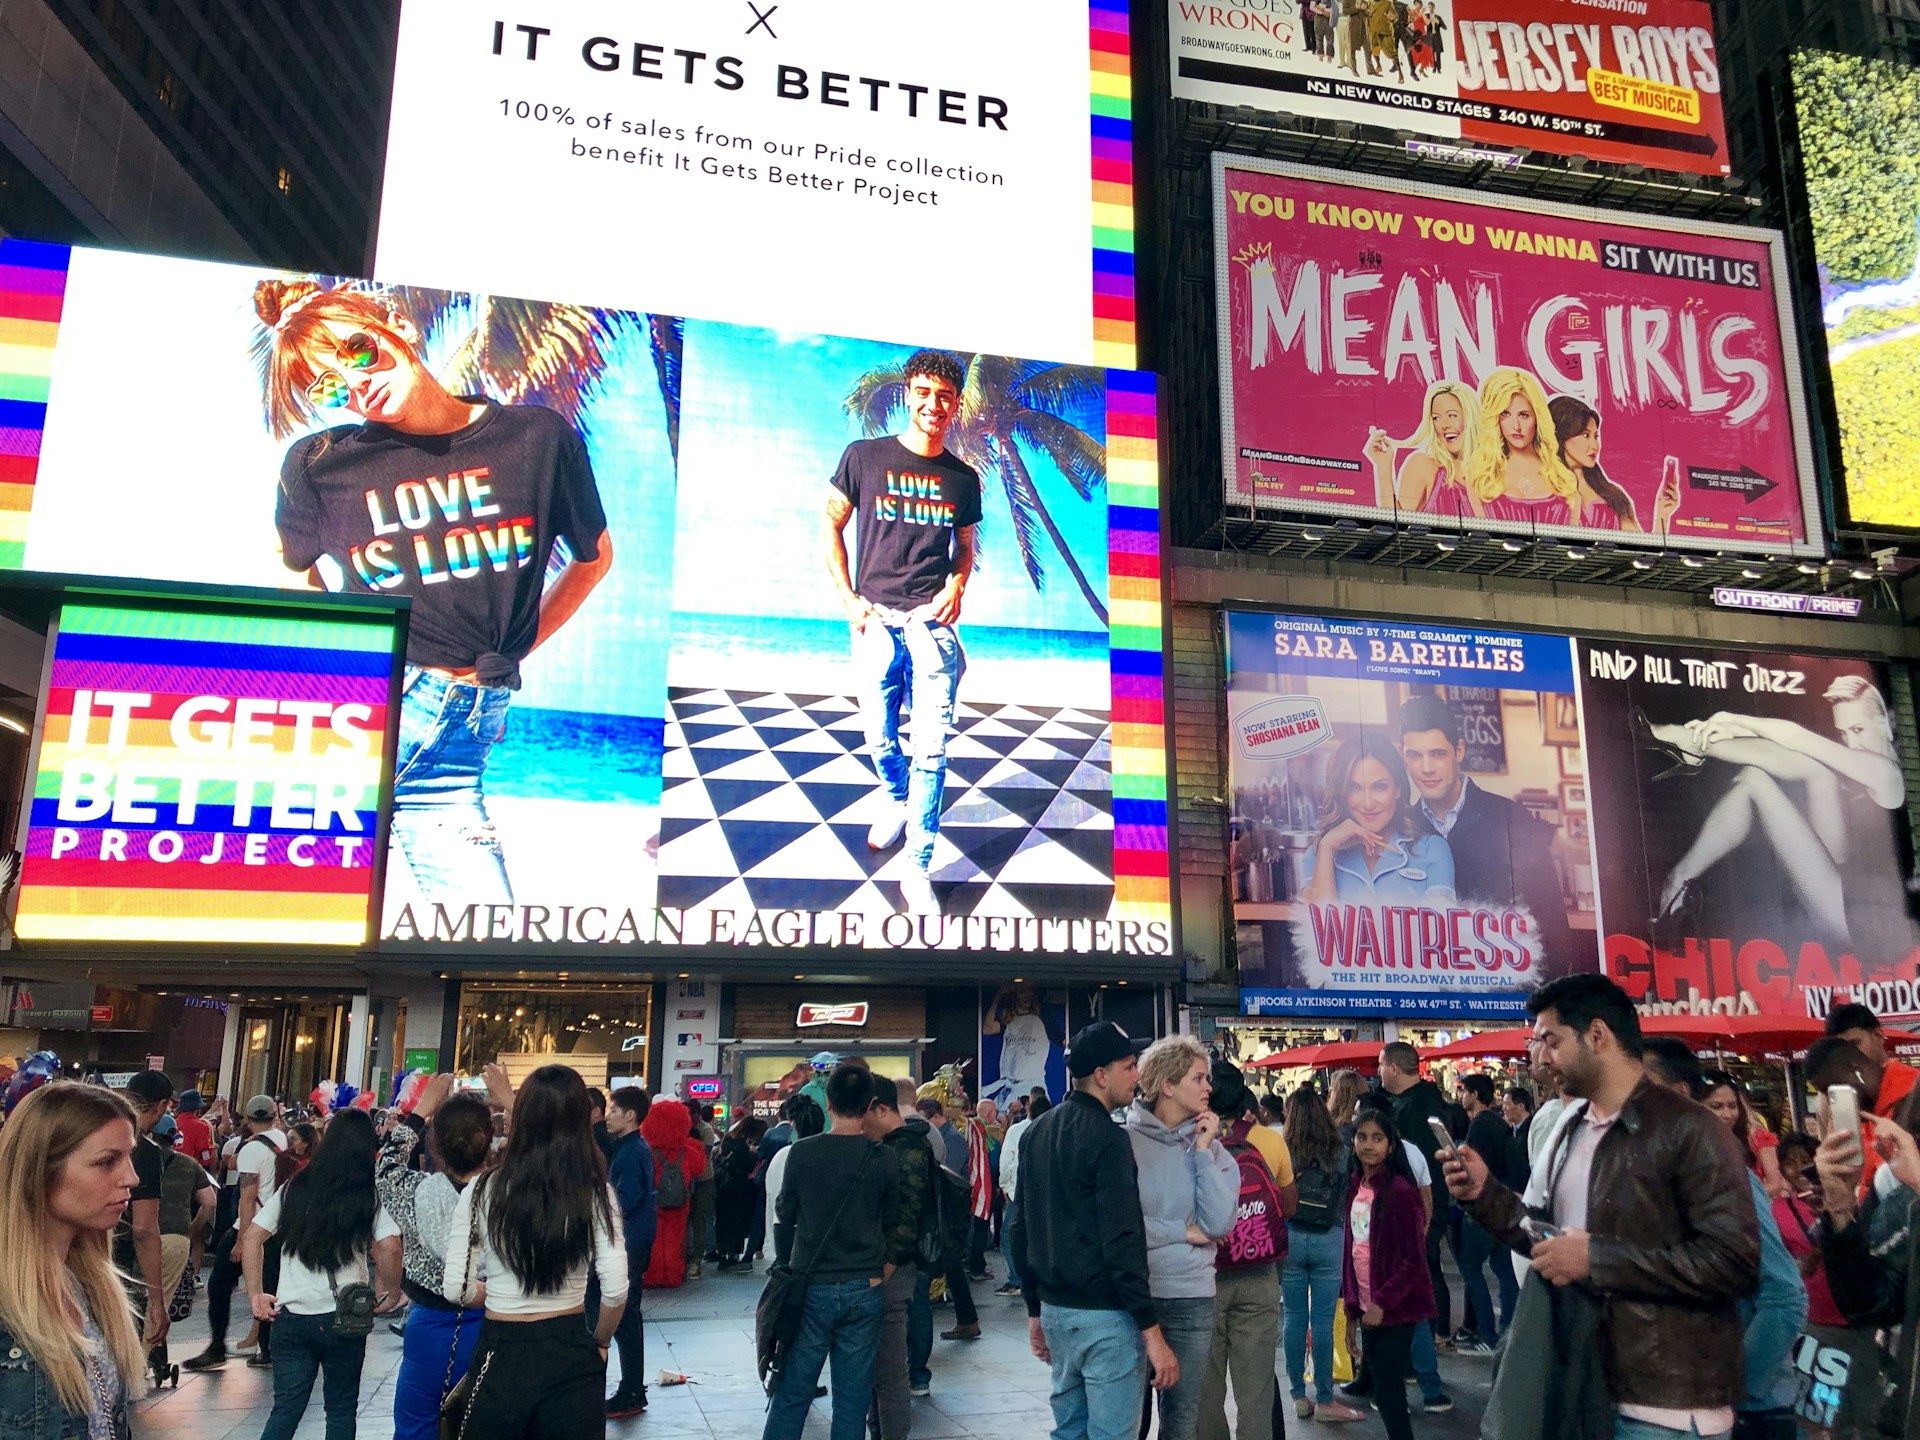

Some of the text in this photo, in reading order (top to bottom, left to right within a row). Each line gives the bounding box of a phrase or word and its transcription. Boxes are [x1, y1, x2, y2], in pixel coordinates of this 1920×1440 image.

[1178, 2, 1294, 43] WRONG
[1181, 36, 1291, 60] BROADWAYGOESWRONG.COM
[1456, 20, 1721, 94] JERSEY BOYS
[492, 20, 1009, 131] IT GETS BETTER
[1335, 84, 1371, 100] NEW
[1375, 90, 1432, 110] WORLD
[1436, 100, 1491, 119] STAGES
[1498, 109, 1526, 125] 340
[1530, 114, 1549, 128] W.
[1584, 124, 1605, 137] ST.
[1594, 81, 1693, 116] BEST MUSICAL
[499, 98, 1005, 187] 100% of sales from our Pride collection
[571, 138, 938, 207] benefit It Gets Better Project
[1230, 189, 1760, 288] YOU KNOW YOU WANNA SIT WITH US.
[1250, 256, 1770, 426] MEAN GIRLS
[365, 466, 500, 536] LOVE
[886, 470, 942, 500] LOVE
[1299, 485, 1355, 496] JEFF RICHMOND
[875, 496, 956, 528] IS LOVE
[350, 515, 534, 591] IS LOVE
[1718, 590, 1856, 614] OUTFRONT PRIME
[1274, 620, 1327, 632] ORIGINAL
[1330, 625, 1363, 635] MUSIC
[1367, 628, 1380, 637] BY
[1383, 629, 1416, 639] 7-TIME
[1475, 636, 1523, 647] NOMINEE
[1275, 633, 1525, 672] SARA BAREILLES
[1590, 649, 1806, 695] AND ALL THAT JAZZ
[68, 689, 373, 758] IT GETS
[1243, 709, 1317, 734] NOW STARRING
[1246, 718, 1320, 747] SHOSHANA BEAN
[57, 759, 365, 831] BETTER
[391, 902, 1170, 955] AMERICAN EAGLE OUTFITTERS
[1309, 903, 1531, 972] WAITRESS
[687, 982, 705, 997] NBA
[1332, 972, 1515, 987] THE HIT BROADWAY MUSICAL
[1603, 934, 1920, 1015] CHICA
[1253, 996, 1293, 1007] BROOKS
[1296, 998, 1346, 1007] ATKINSON
[1349, 998, 1392, 1008] THEATRE
[1400, 999, 1417, 1009] 256
[1450, 1000, 1462, 1010] ST.
[1805, 986, 1832, 1020] NY
[690, 1081, 719, 1094] OPEN
[753, 1100, 767, 1108] THE
[753, 1108, 769, 1116] FOR
